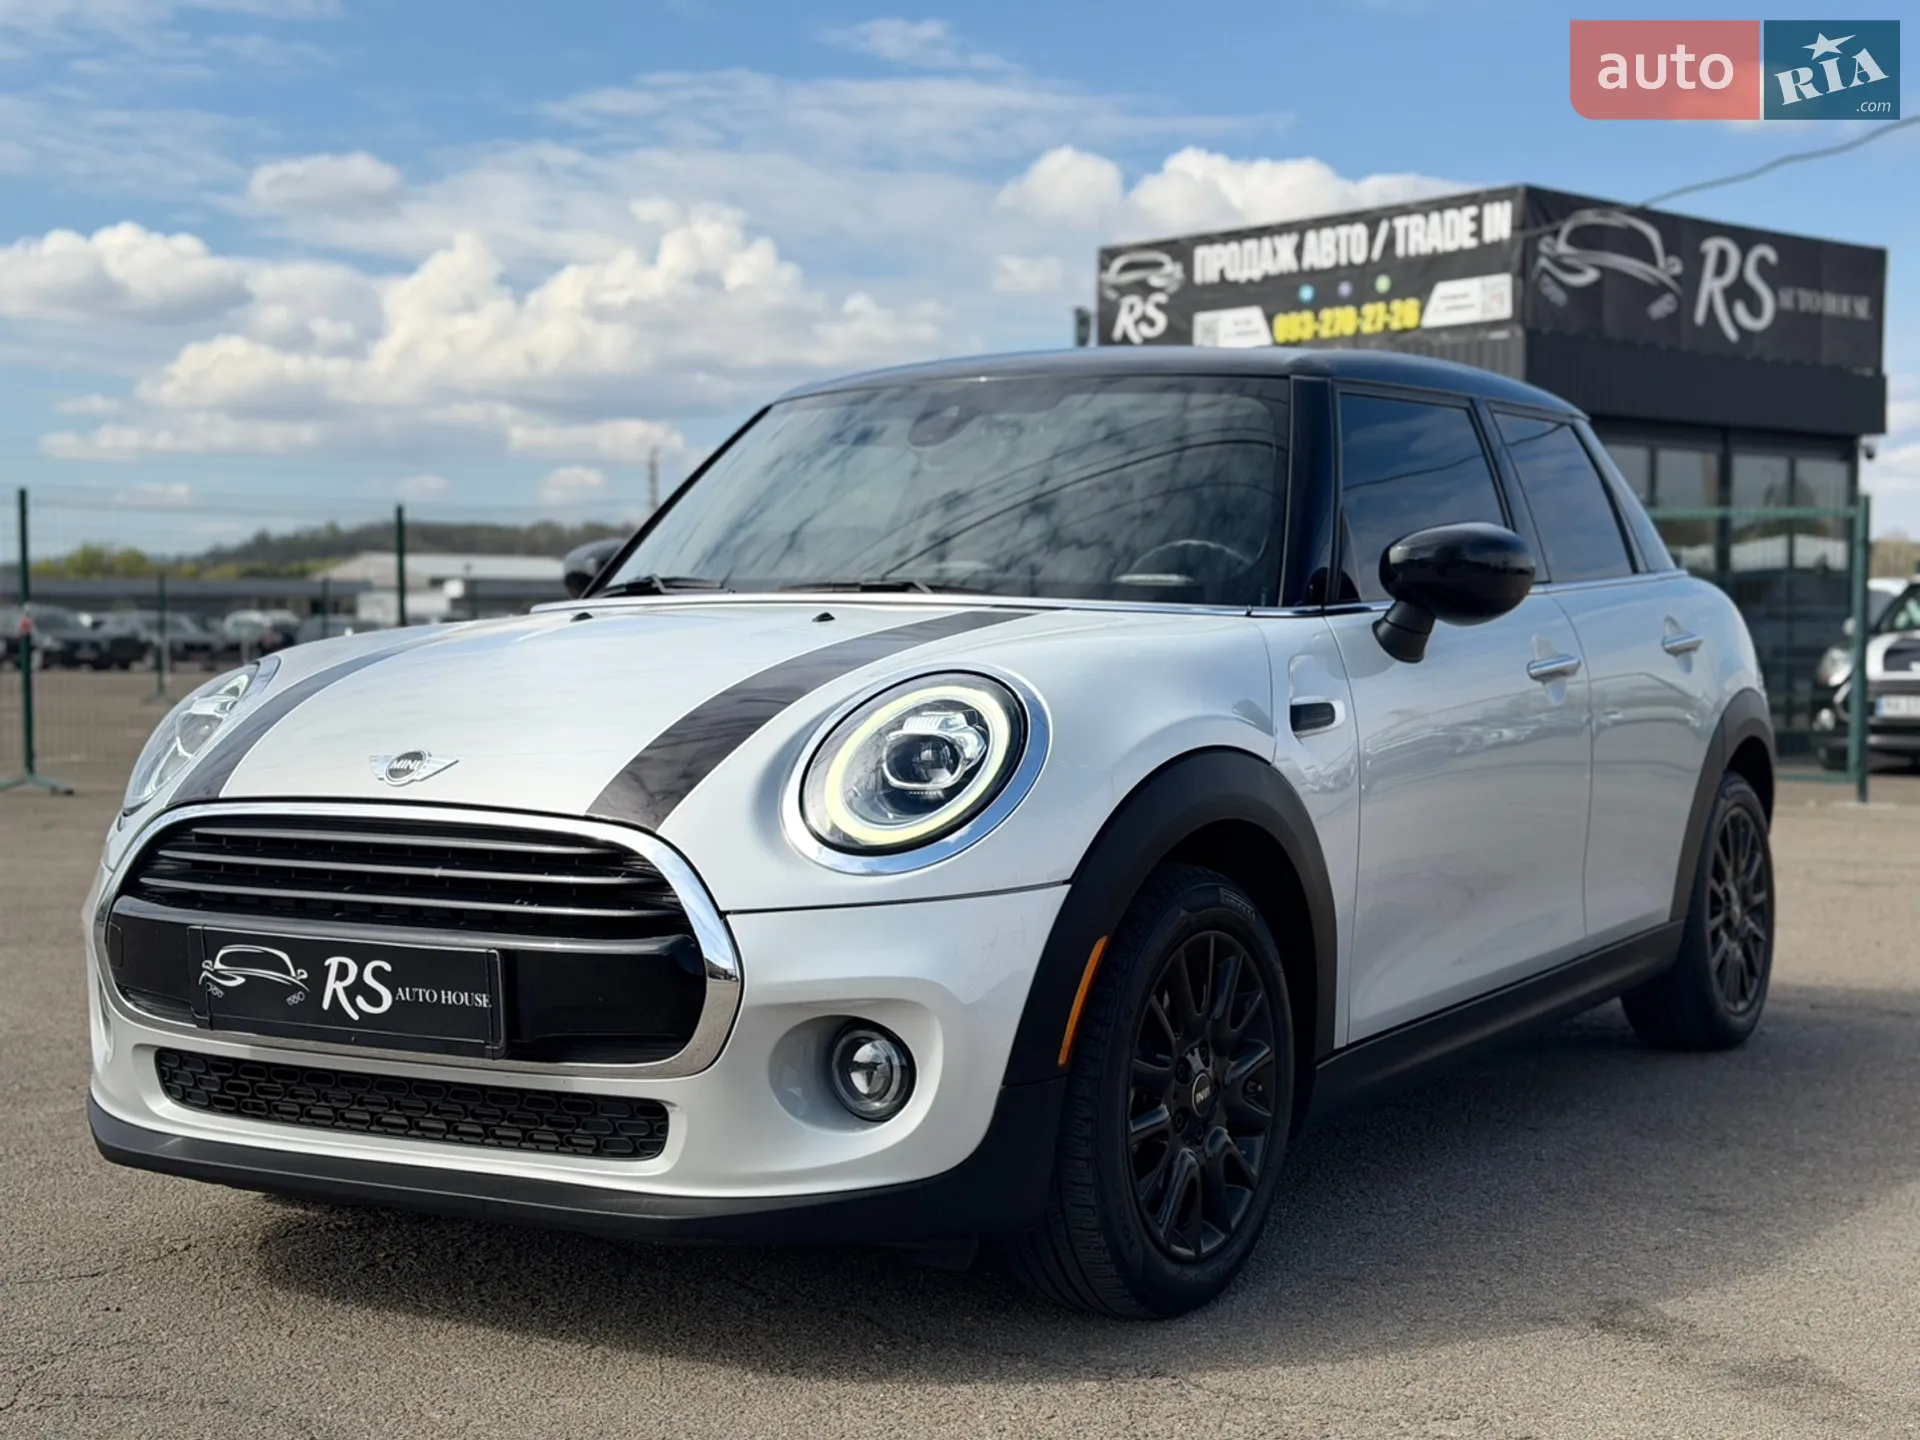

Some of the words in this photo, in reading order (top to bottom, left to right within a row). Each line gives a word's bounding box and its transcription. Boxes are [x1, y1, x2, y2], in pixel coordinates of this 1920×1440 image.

[1193, 233, 1299, 284] ПРОДАЖ
[1302, 222, 1369, 271] АВТО
[1371, 219, 1389, 262] /
[1393, 204, 1479, 257] TRADE
[1482, 201, 1512, 244] IN
[1112, 291, 1169, 345] RS
[1694, 236, 1778, 343] RS
[389, 759, 420, 771] MINI
[321, 956, 393, 1021] RS
[395, 986, 437, 1004] AUTO
[441, 989, 492, 1008] HOUSE
